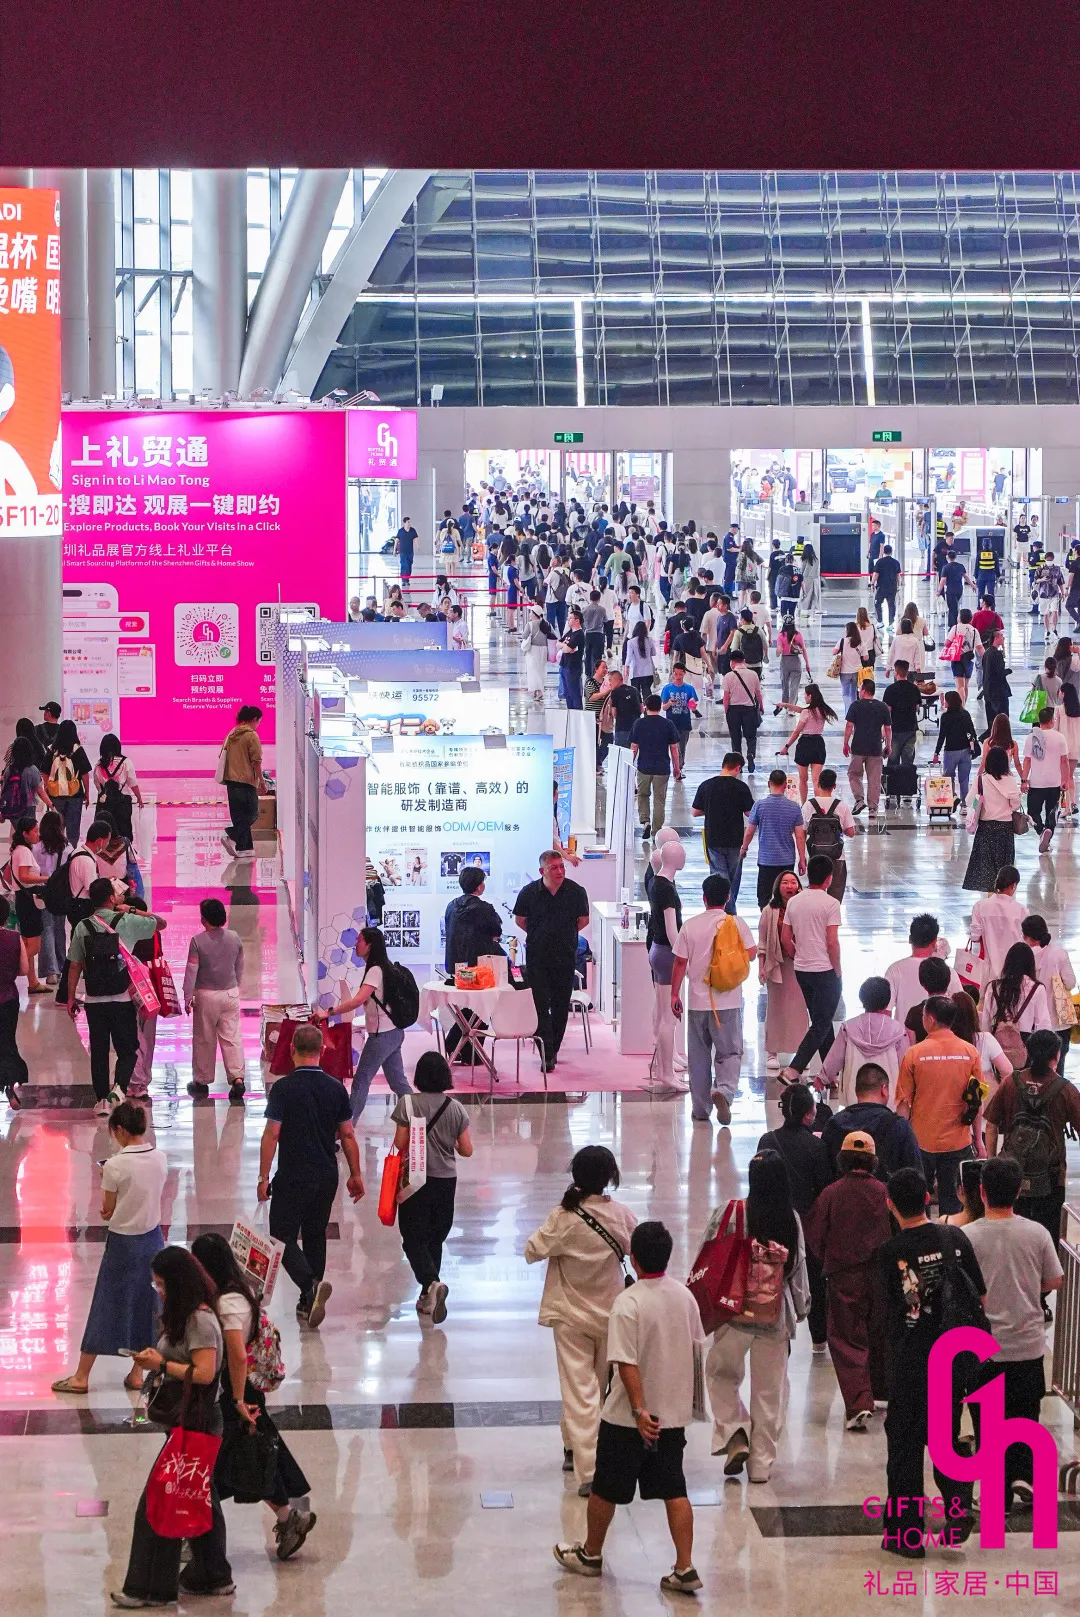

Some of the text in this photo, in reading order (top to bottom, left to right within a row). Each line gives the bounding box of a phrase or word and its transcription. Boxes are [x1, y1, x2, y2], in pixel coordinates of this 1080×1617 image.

[0, 203, 22, 221] DI
[71, 435, 209, 468] 上礼贸通
[72, 474, 210, 488] Sign in to Li Mao Tong
[143, 494, 280, 516] 观展一键即约
[0, 504, 60, 527] F11-20
[63, 522, 102, 533] Explore
[104, 522, 153, 533] Products,
[154, 522, 180, 531] Book
[181, 522, 206, 531] Your
[206, 522, 236, 531] Visits
[237, 522, 247, 531] in
[255, 522, 281, 531] Click
[66, 559, 86, 567] Smart
[86, 559, 115, 568] Sourcing
[115, 559, 144, 567] Platform
[144, 559, 152, 567] of
[152, 559, 163, 567] the
[163, 559, 194, 567] Shenzhen
[194, 559, 211, 567] Gifts
[216, 559, 236, 567] Home
[236, 559, 255, 567] Show
[190, 674, 224, 683] 扫码立即
[412, 693, 440, 702] 95572
[400, 798, 468, 812] 研发制造商
